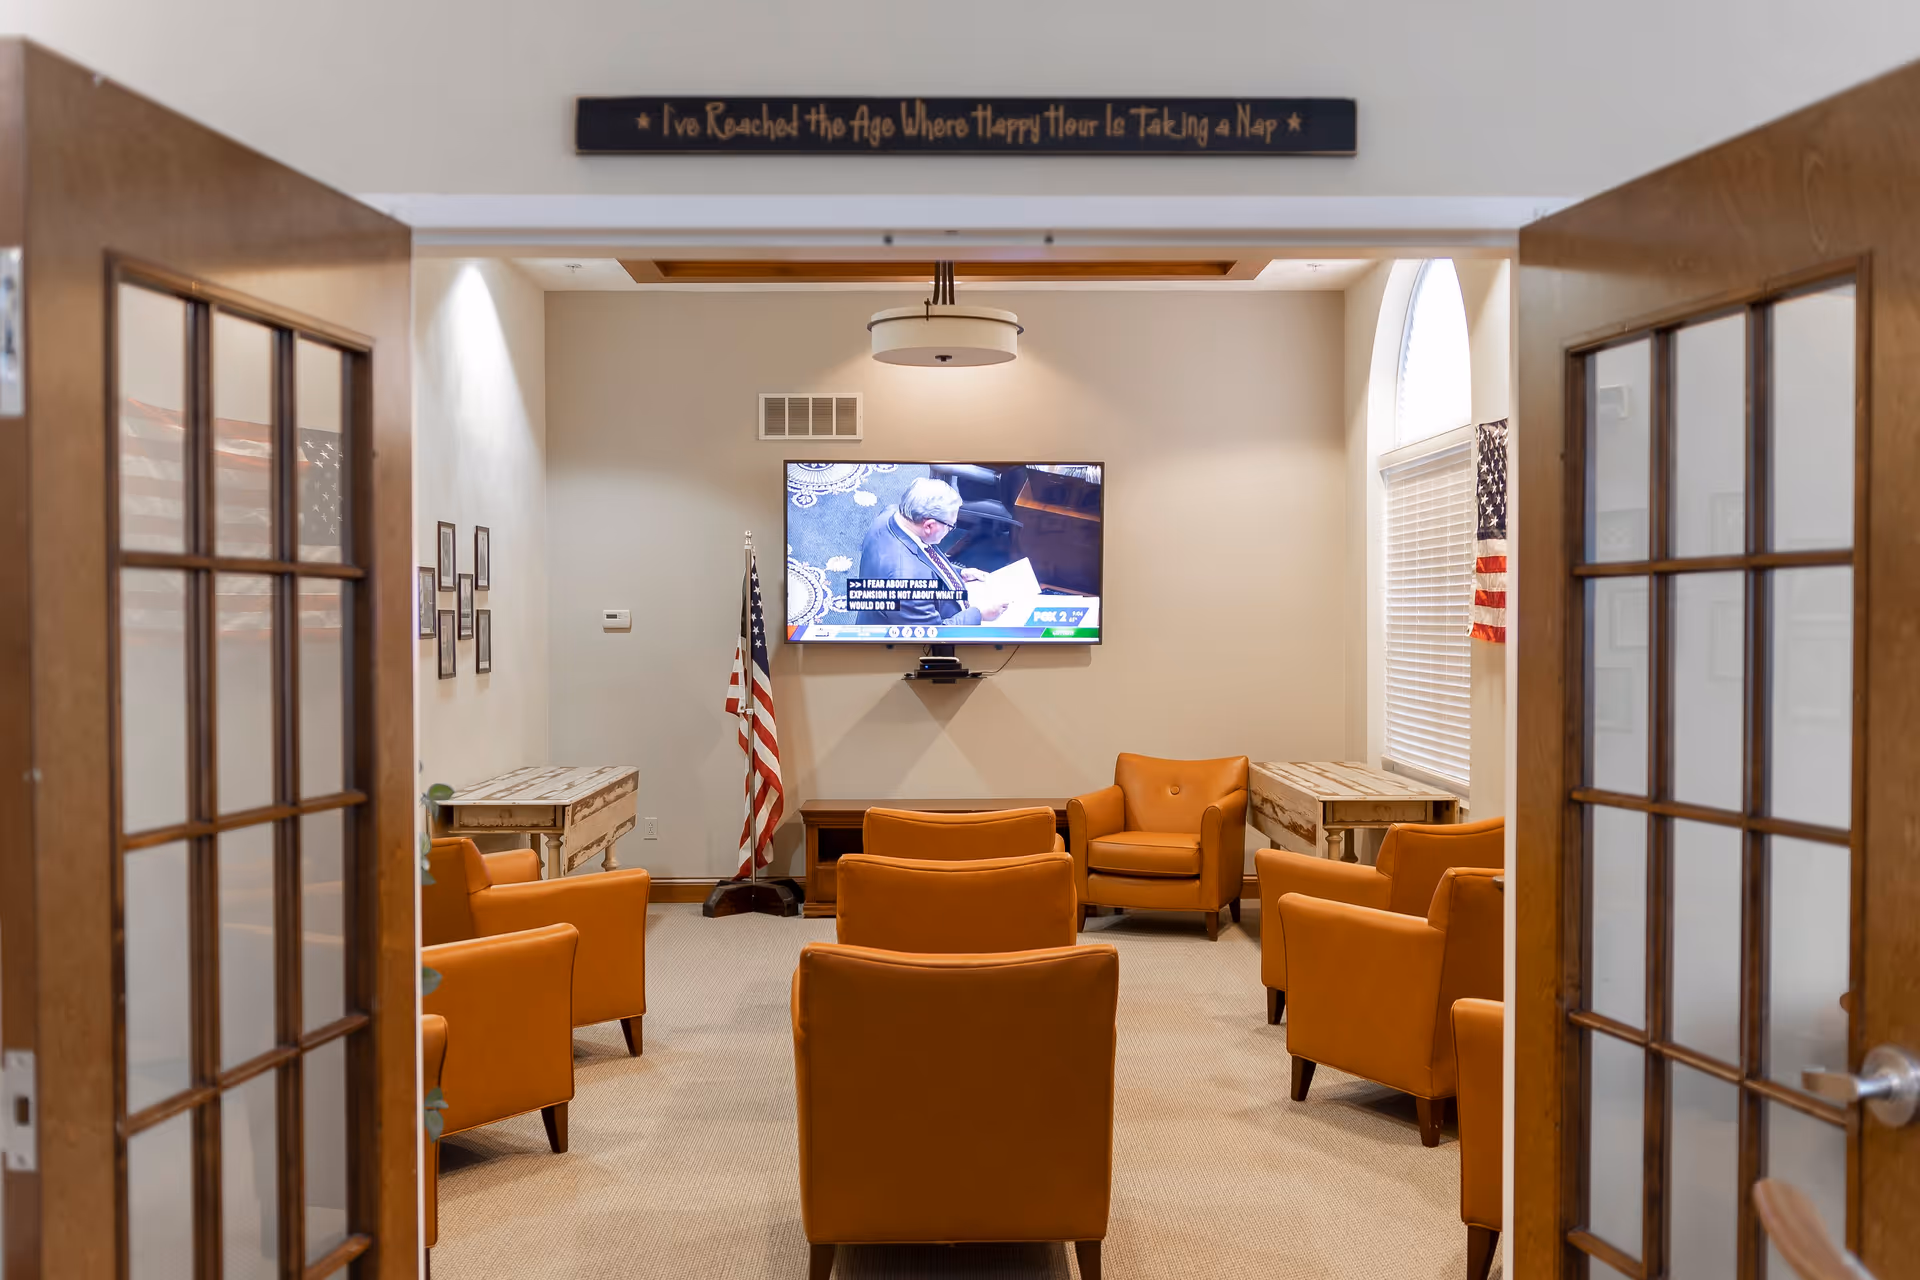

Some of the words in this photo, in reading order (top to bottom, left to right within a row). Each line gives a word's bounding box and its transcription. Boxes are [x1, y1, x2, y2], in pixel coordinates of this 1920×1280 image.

[663, 102, 699, 136] I've
[705, 102, 798, 141] Reached
[805, 102, 846, 141] the
[850, 104, 895, 147] Age
[901, 98, 969, 141] Where
[971, 102, 1040, 145] Happy
[1044, 102, 1099, 139] Hour
[1106, 102, 1125, 138] Is
[1129, 105, 1208, 148] Taking
[1214, 116, 1230, 138] a
[1236, 102, 1278, 145] Nap
[862, 580, 867, 588] I
[867, 580, 885, 588] FEAR
[886, 580, 909, 588] ABOUT
[910, 580, 927, 588] PASS
[849, 590, 888, 599] EXPANSION
[888, 590, 896, 599] IS
[897, 590, 911, 599] NOT
[912, 590, 935, 599] ABOUT
[935, 590, 955, 599] WHAT
[956, 590, 963, 599] IT
[849, 601, 873, 610] WOULD
[875, 601, 885, 610] DO
[886, 601, 895, 610] TO
[1033, 611, 1058, 622] FOX
[1059, 611, 1067, 622] 2
